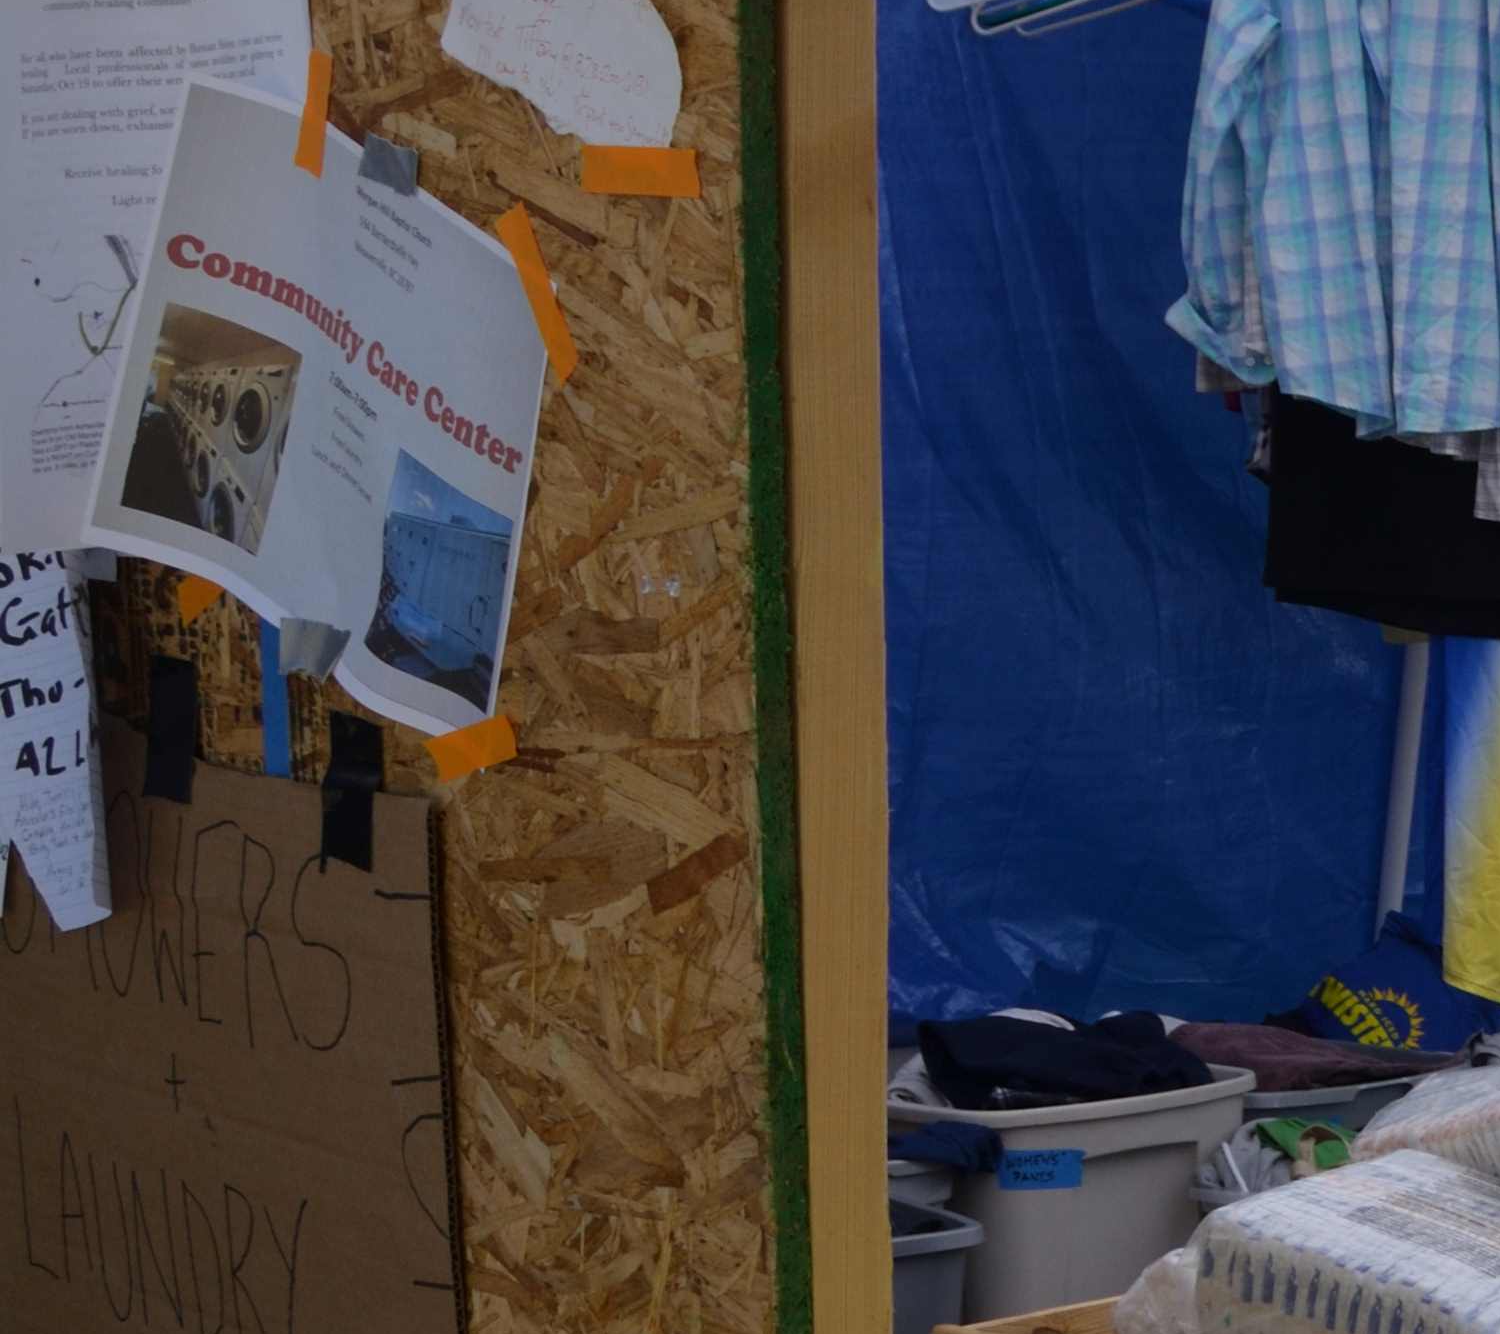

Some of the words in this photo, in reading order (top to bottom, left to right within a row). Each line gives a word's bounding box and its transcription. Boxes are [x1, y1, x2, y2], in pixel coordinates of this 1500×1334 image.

[166, 233, 364, 364] Community
[367, 340, 419, 406] Care
[423, 386, 524, 474] Center
[2, 791, 352, 1051] OWERS
